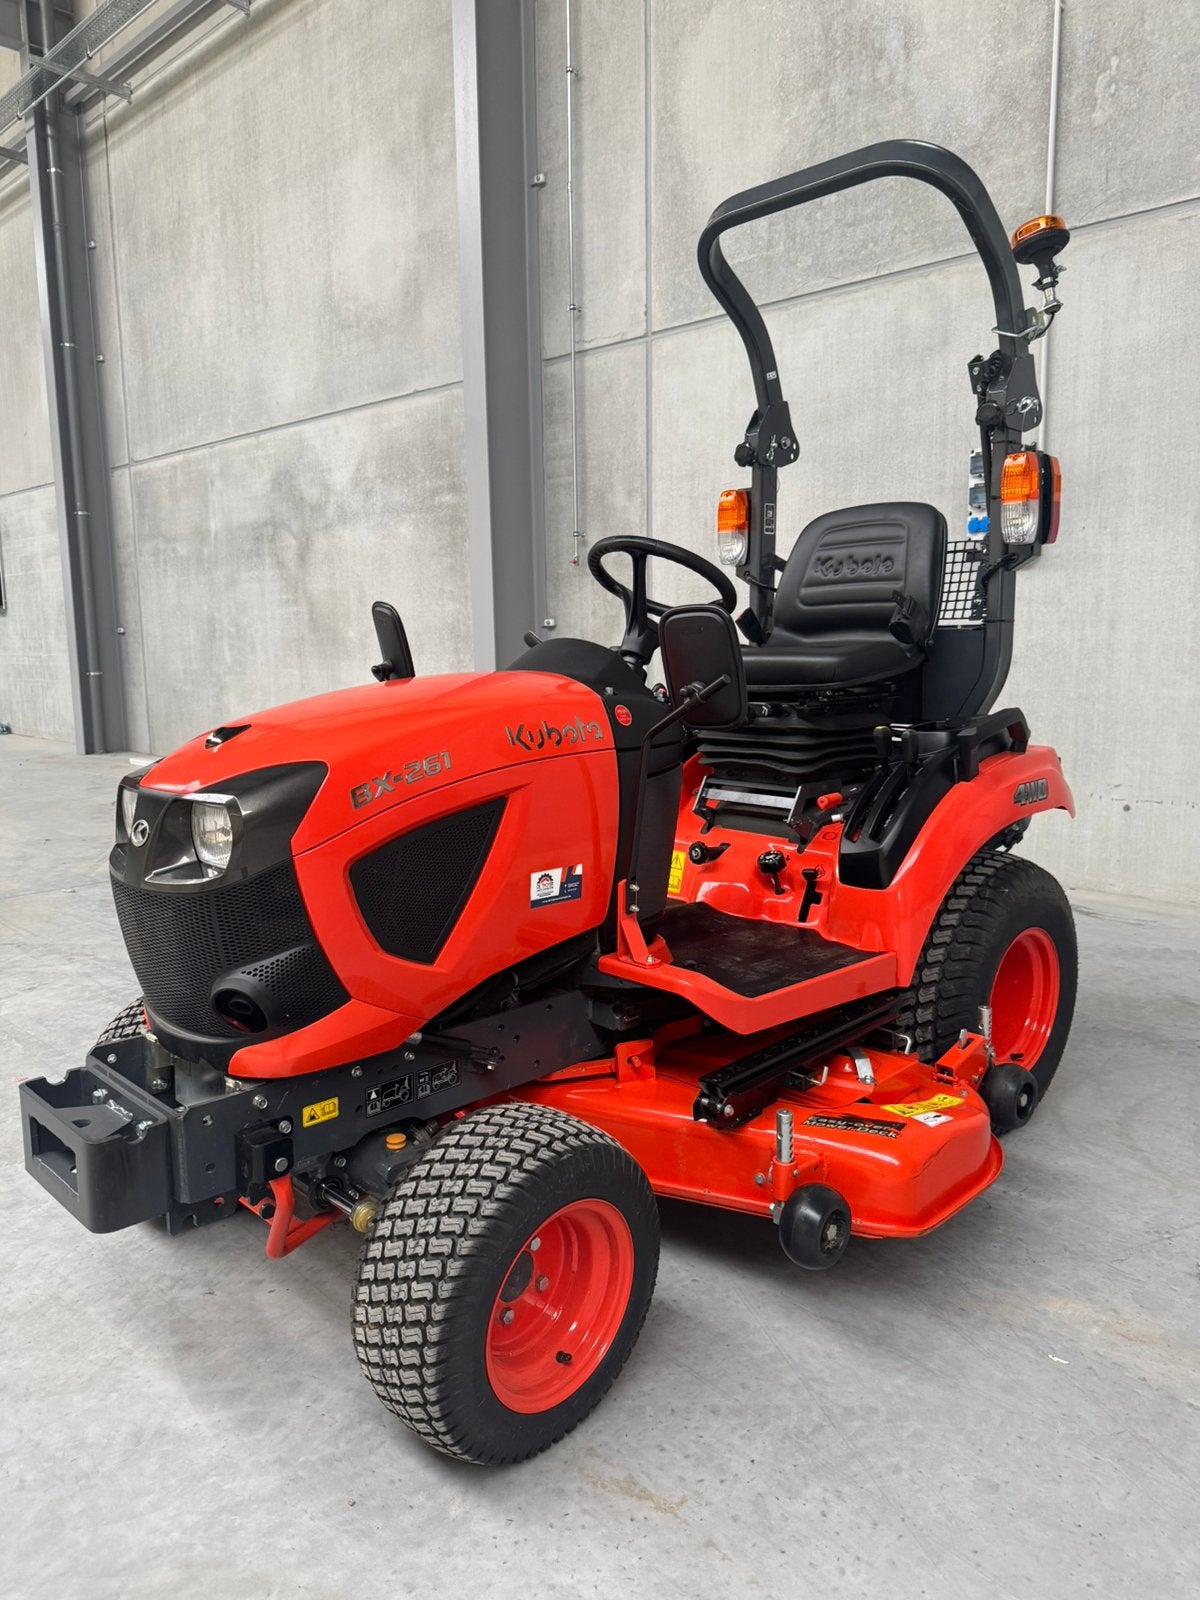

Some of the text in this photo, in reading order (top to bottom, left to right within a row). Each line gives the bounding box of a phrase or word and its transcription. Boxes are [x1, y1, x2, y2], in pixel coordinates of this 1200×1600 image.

[814, 553, 894, 578] Kubota
[505, 715, 603, 751] Kubota
[350, 751, 453, 810] BX-261
